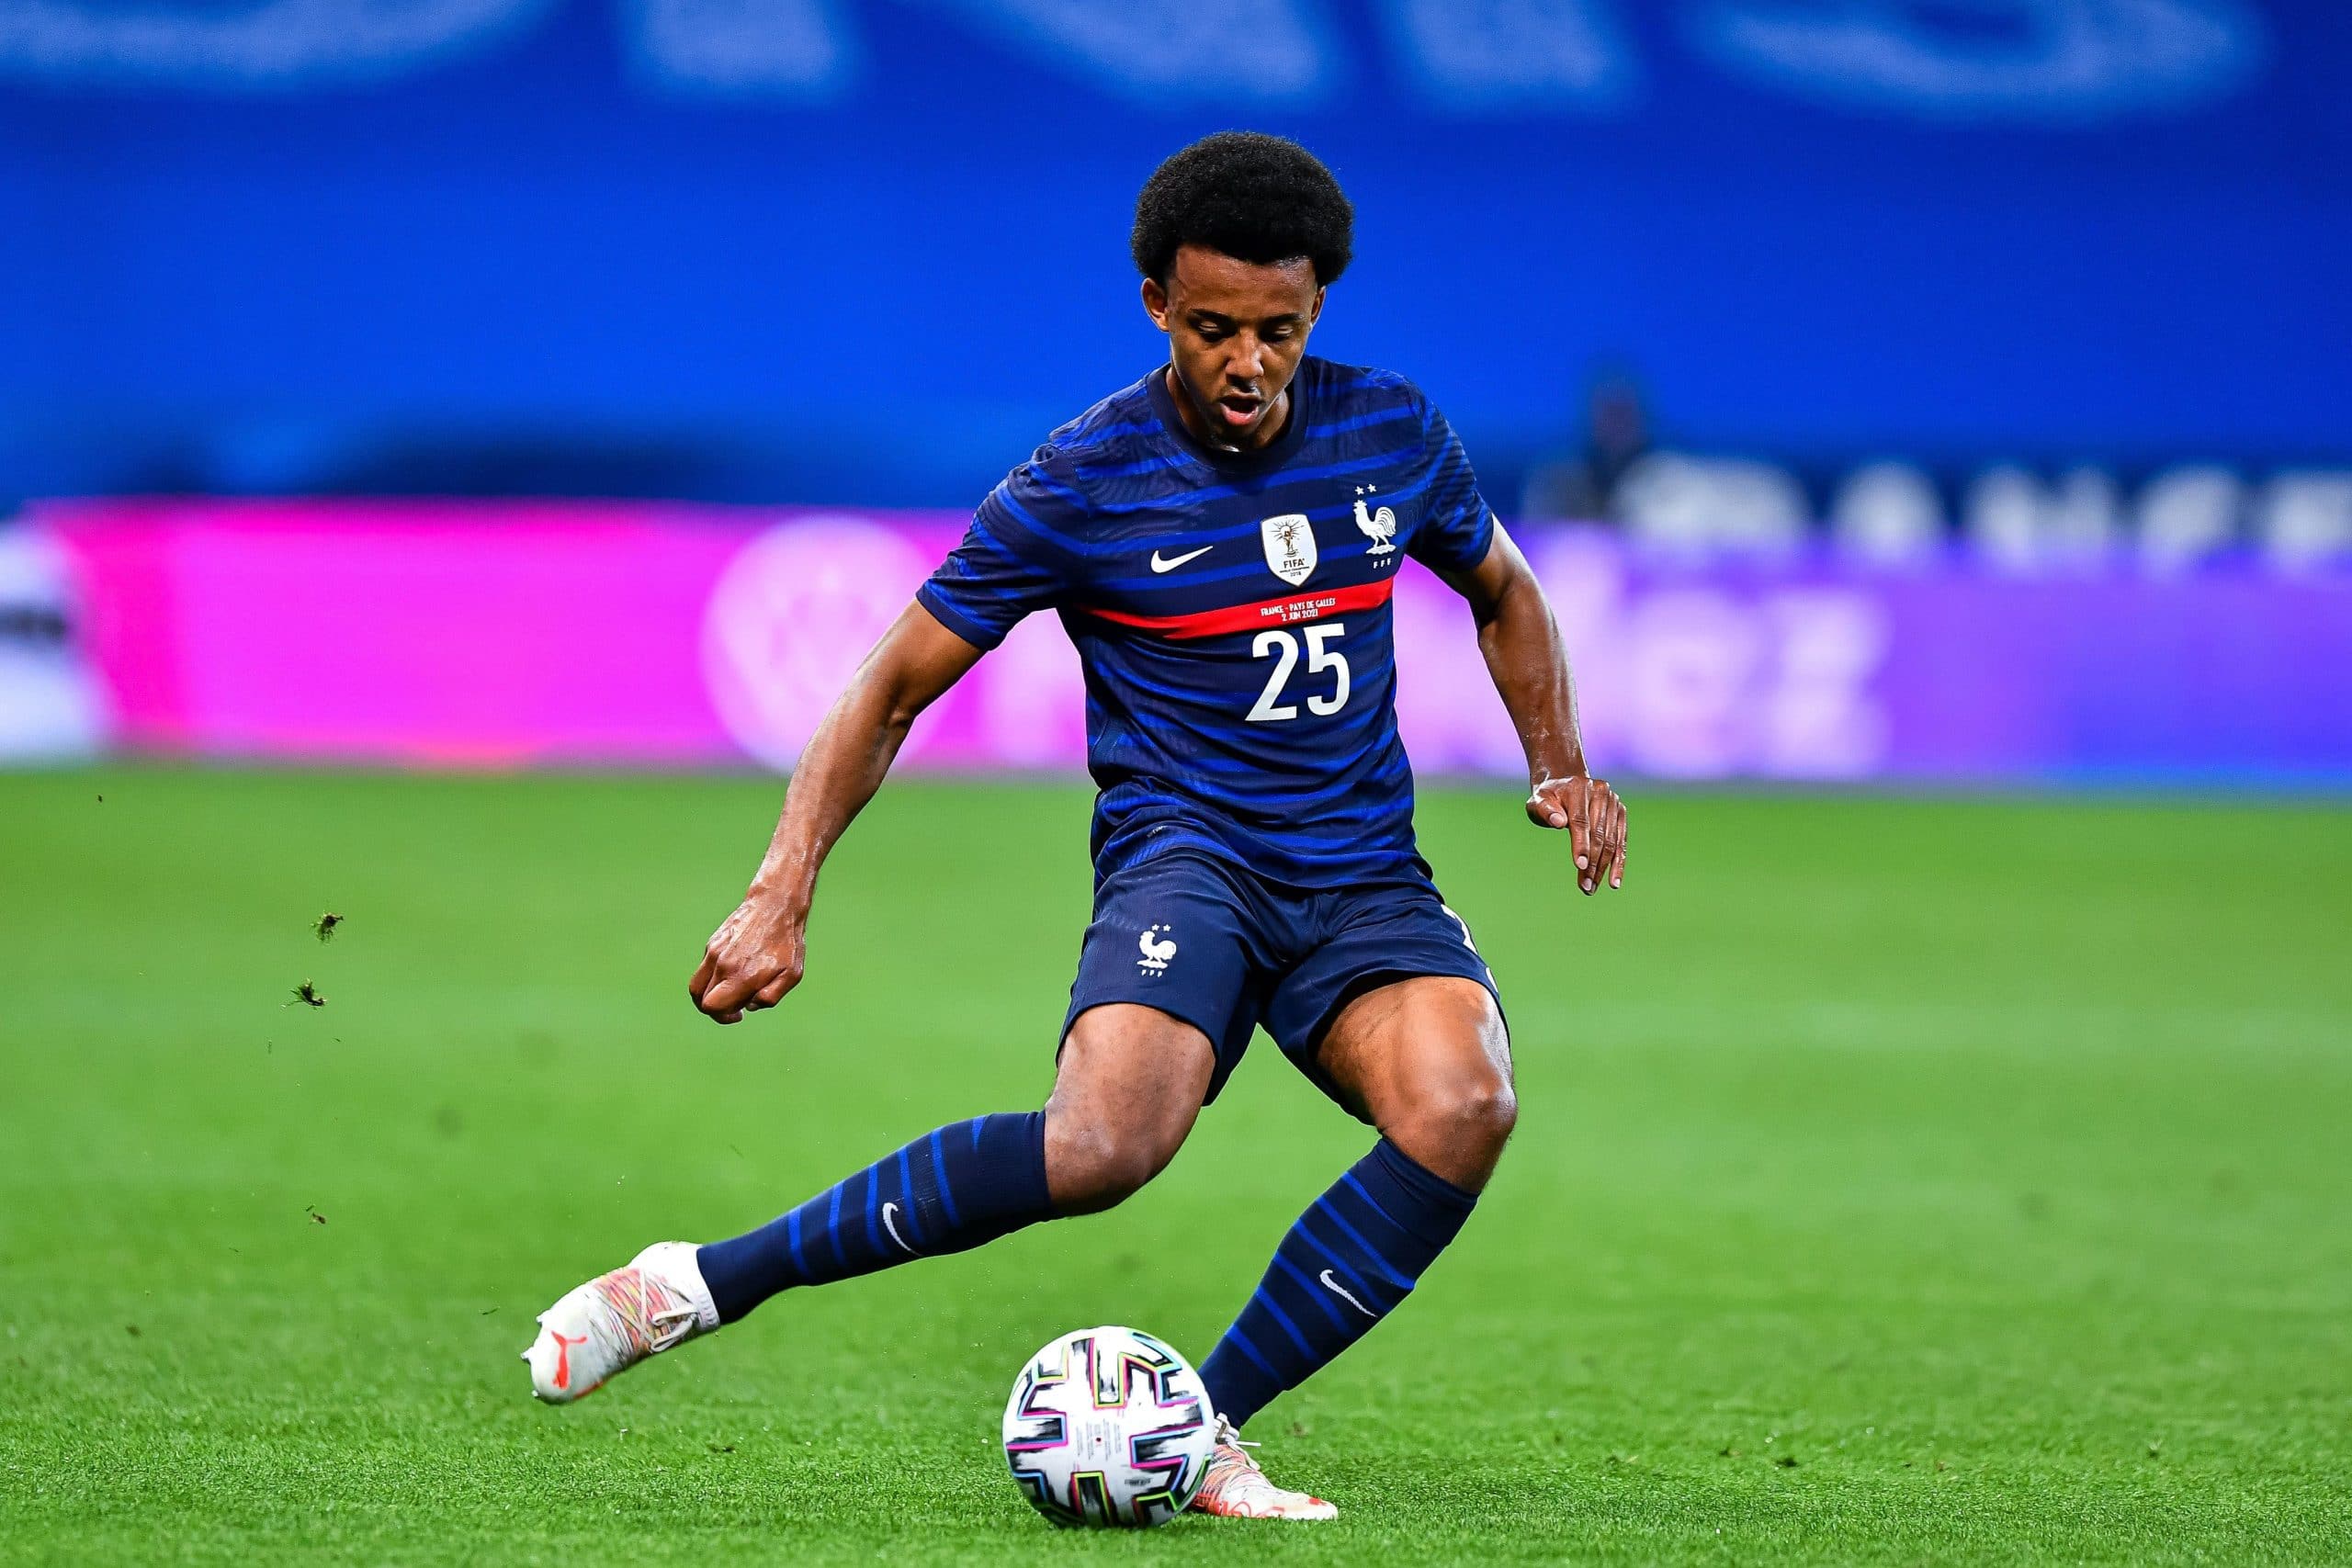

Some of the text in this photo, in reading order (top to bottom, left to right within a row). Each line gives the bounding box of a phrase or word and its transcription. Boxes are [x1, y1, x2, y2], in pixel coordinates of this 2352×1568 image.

[1283, 558, 1305, 569] FIFA
[1373, 558, 1392, 570] FFF
[1261, 605, 1283, 616] FRANCE
[1289, 602, 1305, 611] PAYS
[1306, 601, 1315, 609] DE
[1316, 598, 1336, 607] GALLES
[1282, 609, 1317, 622] 2 JUIN 2021
[1245, 623, 1351, 721] 25
